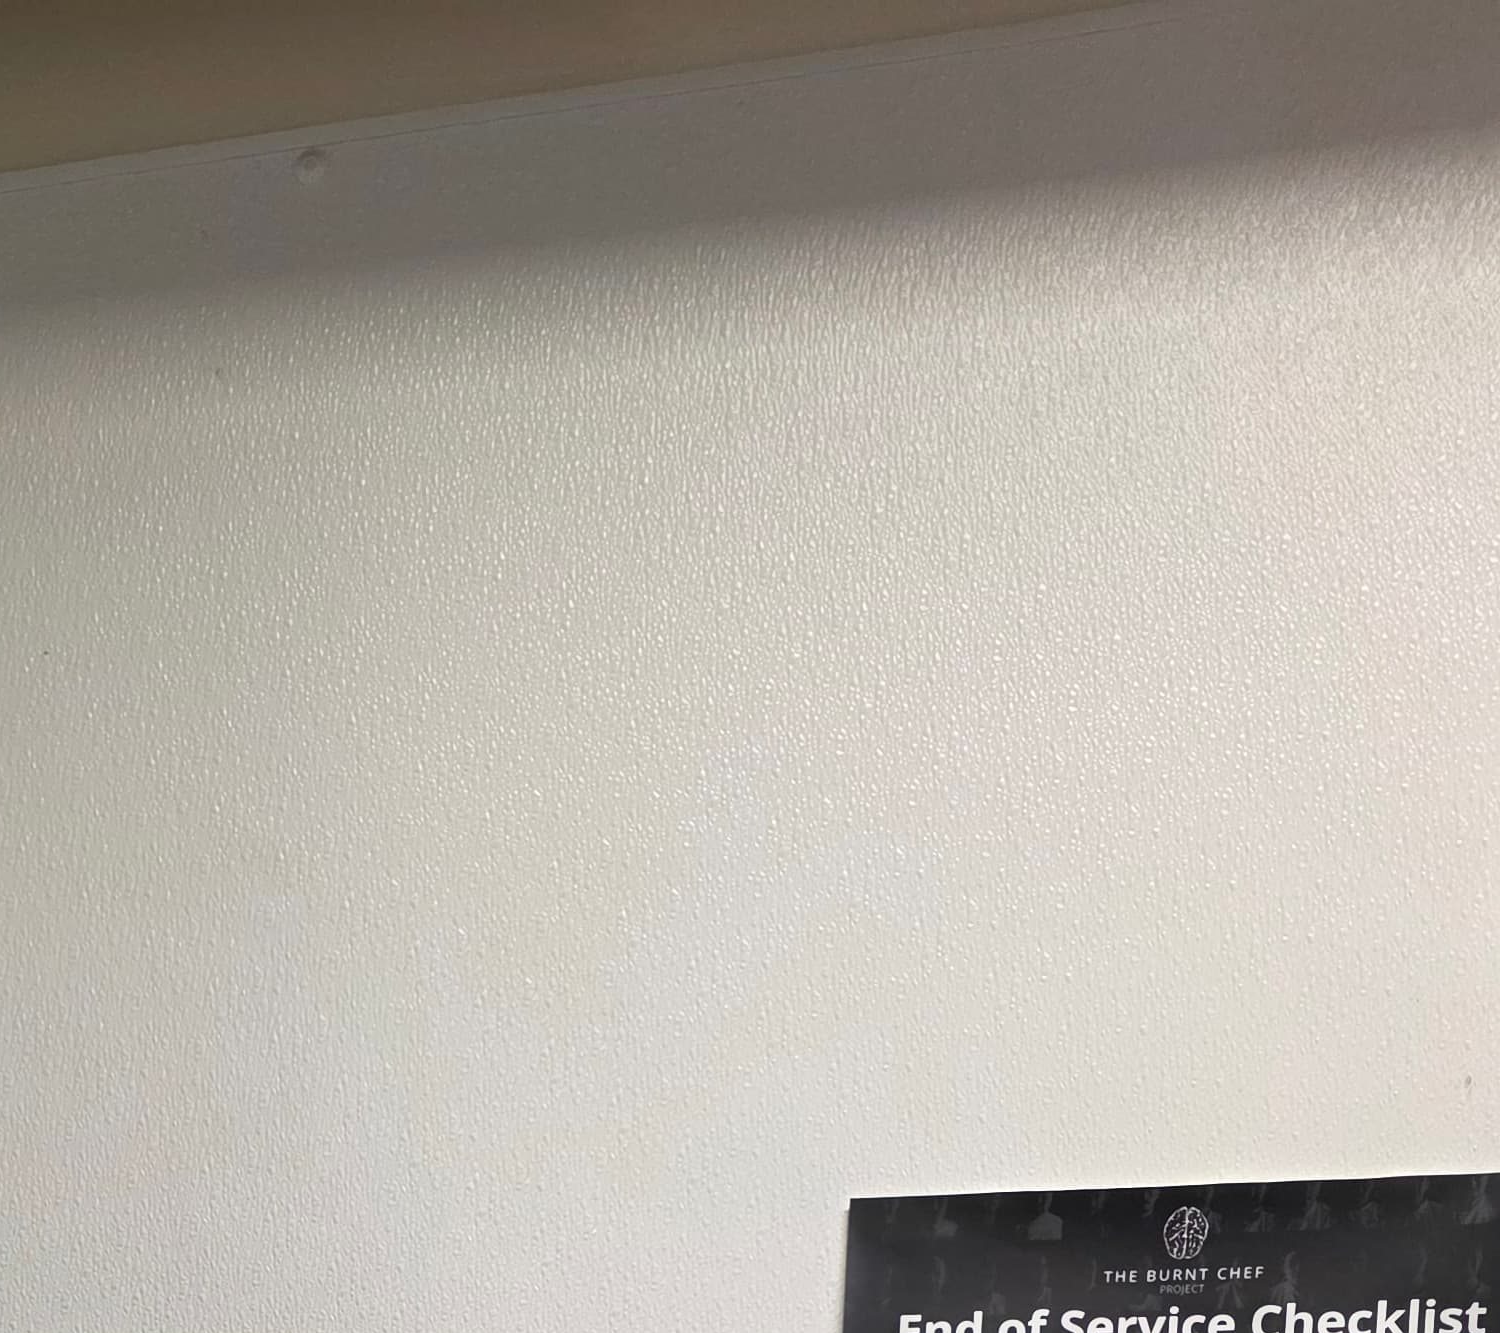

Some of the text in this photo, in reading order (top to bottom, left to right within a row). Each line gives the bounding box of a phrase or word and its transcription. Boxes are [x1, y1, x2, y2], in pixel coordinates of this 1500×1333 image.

[1103, 1266, 1264, 1283] THE BURNT CHEF
[1160, 1284, 1205, 1295] PROJECT
